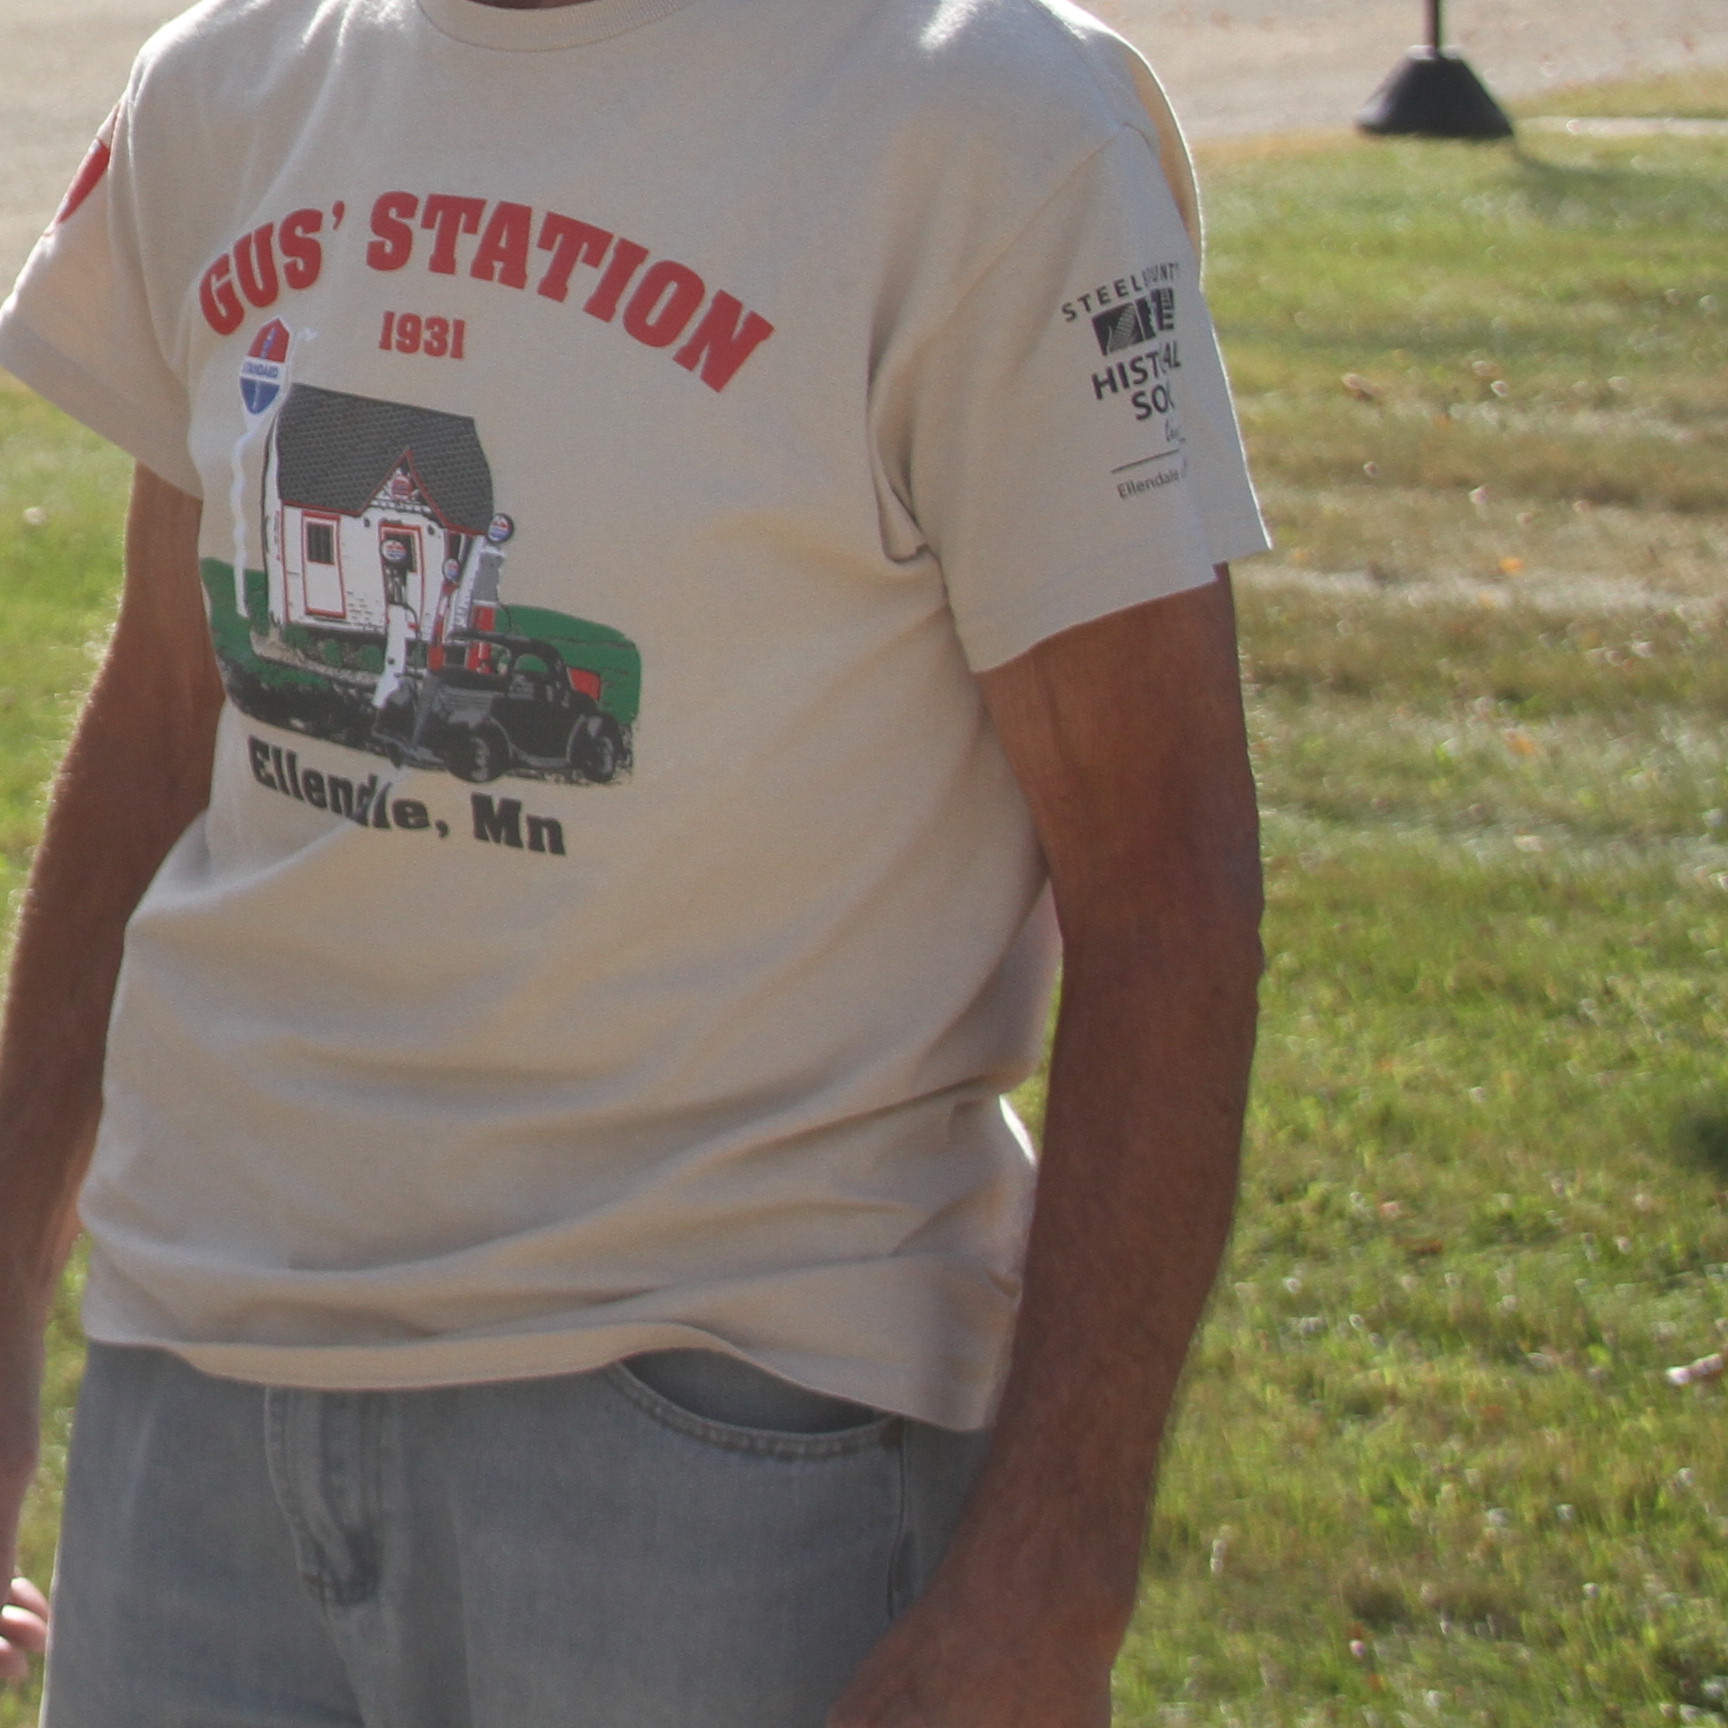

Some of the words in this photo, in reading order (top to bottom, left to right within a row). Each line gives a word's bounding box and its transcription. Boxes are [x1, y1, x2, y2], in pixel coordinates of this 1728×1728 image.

[198, 200, 345, 336] GUS'
[365, 191, 775, 393] STATION
[378, 310, 466, 360] 1931
[470, 791, 567, 856] Mn
